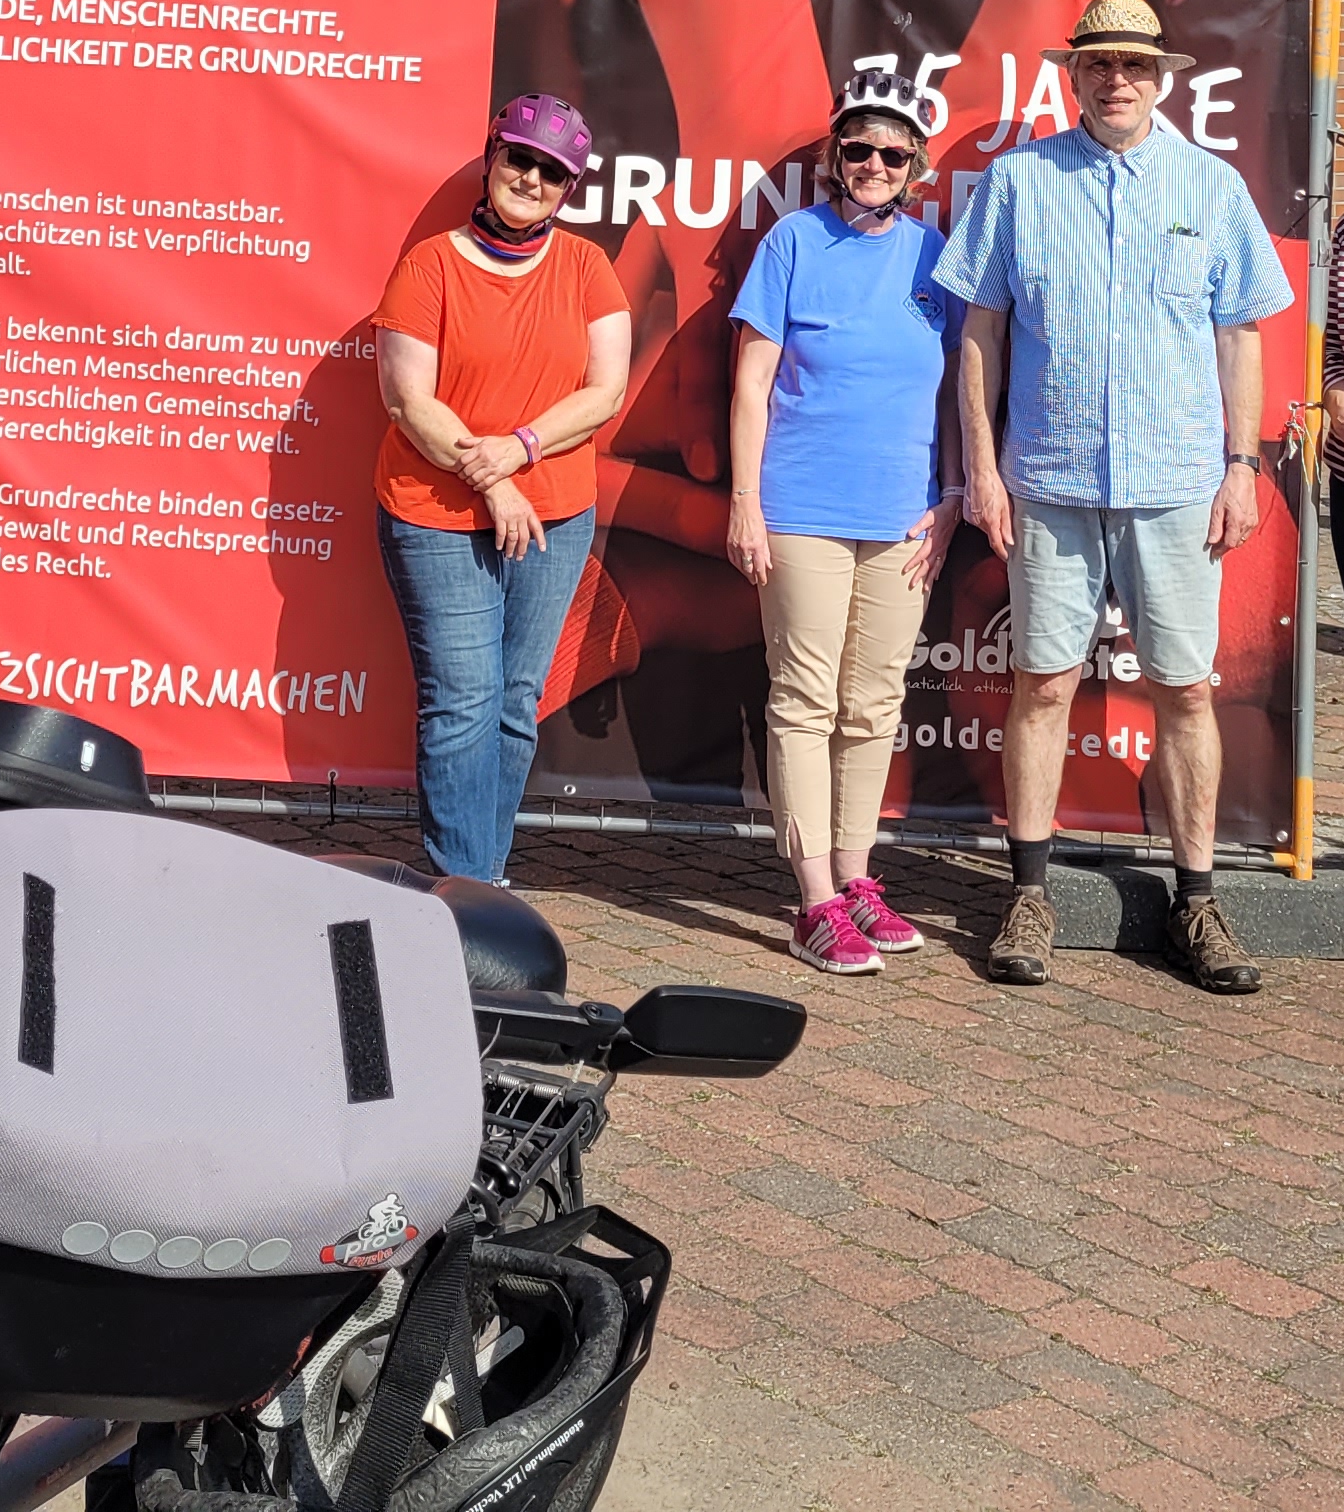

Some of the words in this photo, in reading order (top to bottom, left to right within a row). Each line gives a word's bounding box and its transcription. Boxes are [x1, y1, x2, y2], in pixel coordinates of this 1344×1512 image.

[133, 42, 194, 70] DER
[199, 45, 423, 83] GRUNDRECHTE
[96, 191, 127, 216] ist
[132, 198, 285, 225] unantastbar.
[108, 224, 139, 249] ist
[144, 227, 311, 263] Verpflichtung
[7, 315, 107, 345] bekennt
[112, 323, 158, 348] sich
[164, 325, 245, 353] darum
[250, 336, 279, 355] zu
[285, 336, 375, 359] unverle
[83, 355, 302, 389] Menschenrechten
[145, 391, 320, 428] Gemeinschaft,
[159, 424, 181, 448] in
[188, 425, 231, 451] der
[236, 429, 300, 455] Welt.
[158, 489, 243, 518] binden
[250, 496, 343, 523] Gesetz-
[77, 521, 125, 546] und
[131, 523, 332, 561] Rechtsprechung
[35, 551, 112, 579] Recht.
